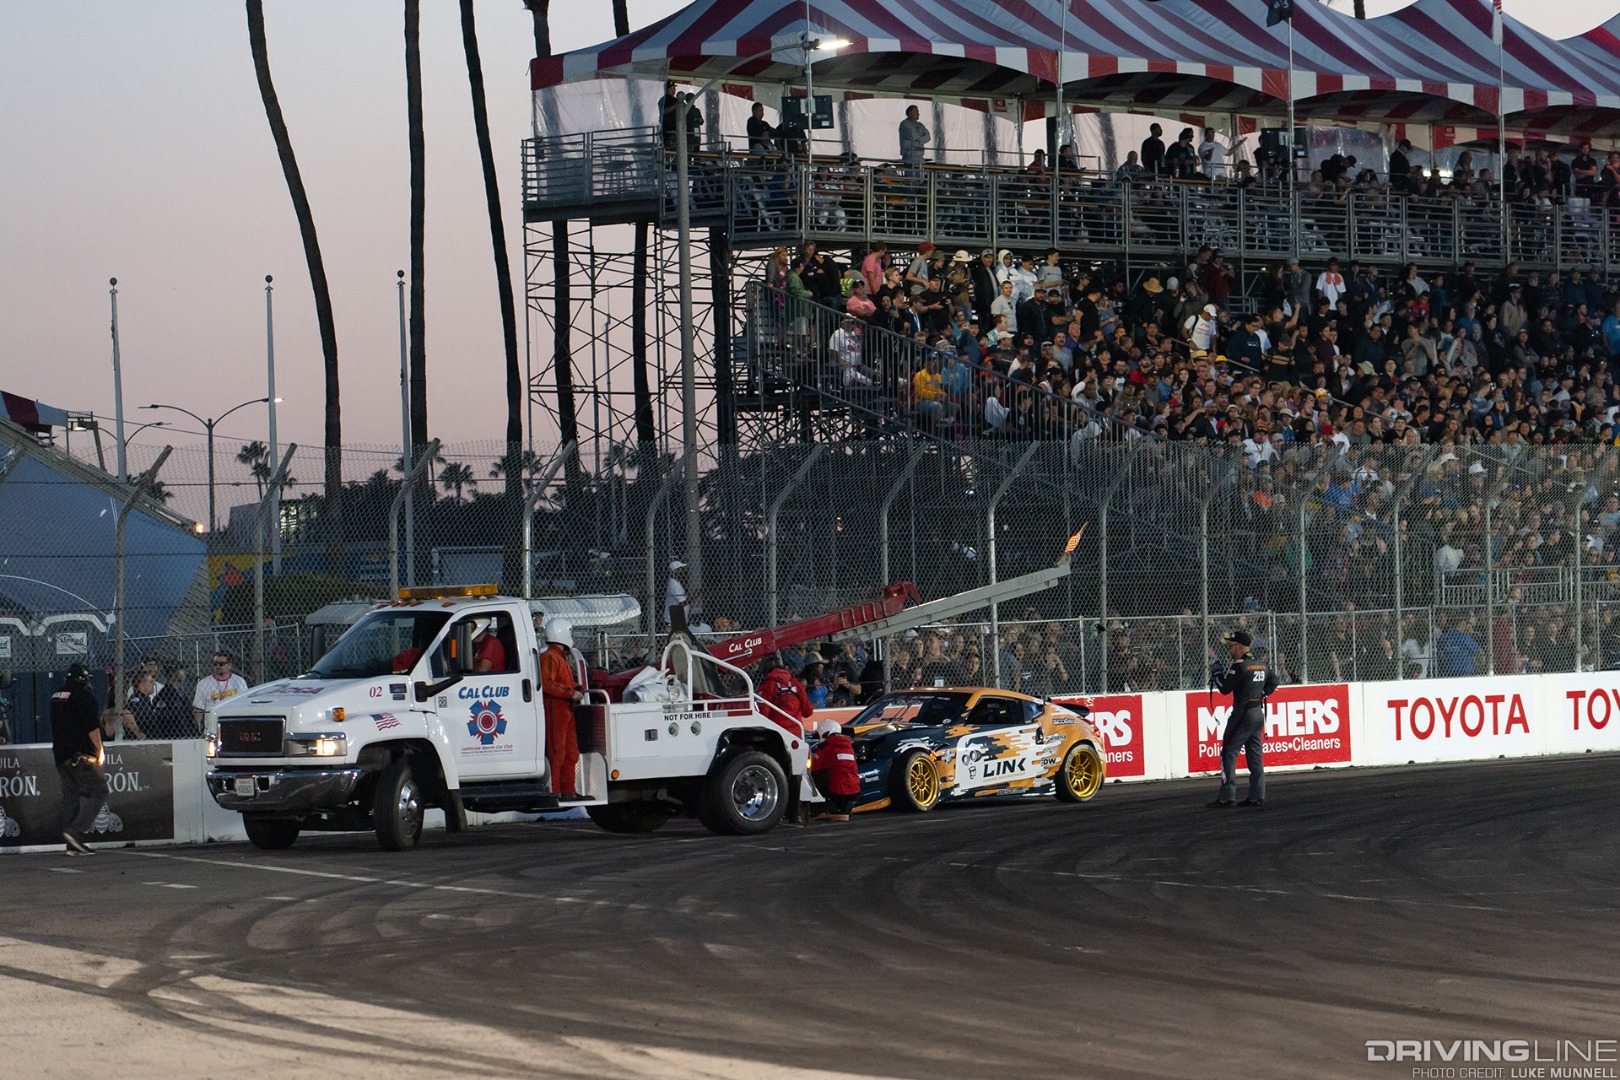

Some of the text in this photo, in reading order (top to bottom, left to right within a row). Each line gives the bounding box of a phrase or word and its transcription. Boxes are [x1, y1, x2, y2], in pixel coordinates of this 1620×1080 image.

[728, 638, 762, 653] CAL CLUB
[1253, 671, 1265, 681] 219
[369, 687, 383, 698] 02
[458, 685, 510, 699] CAL CLUB
[1387, 694, 1530, 741] TOYOTA
[983, 757, 1026, 778] LINK
